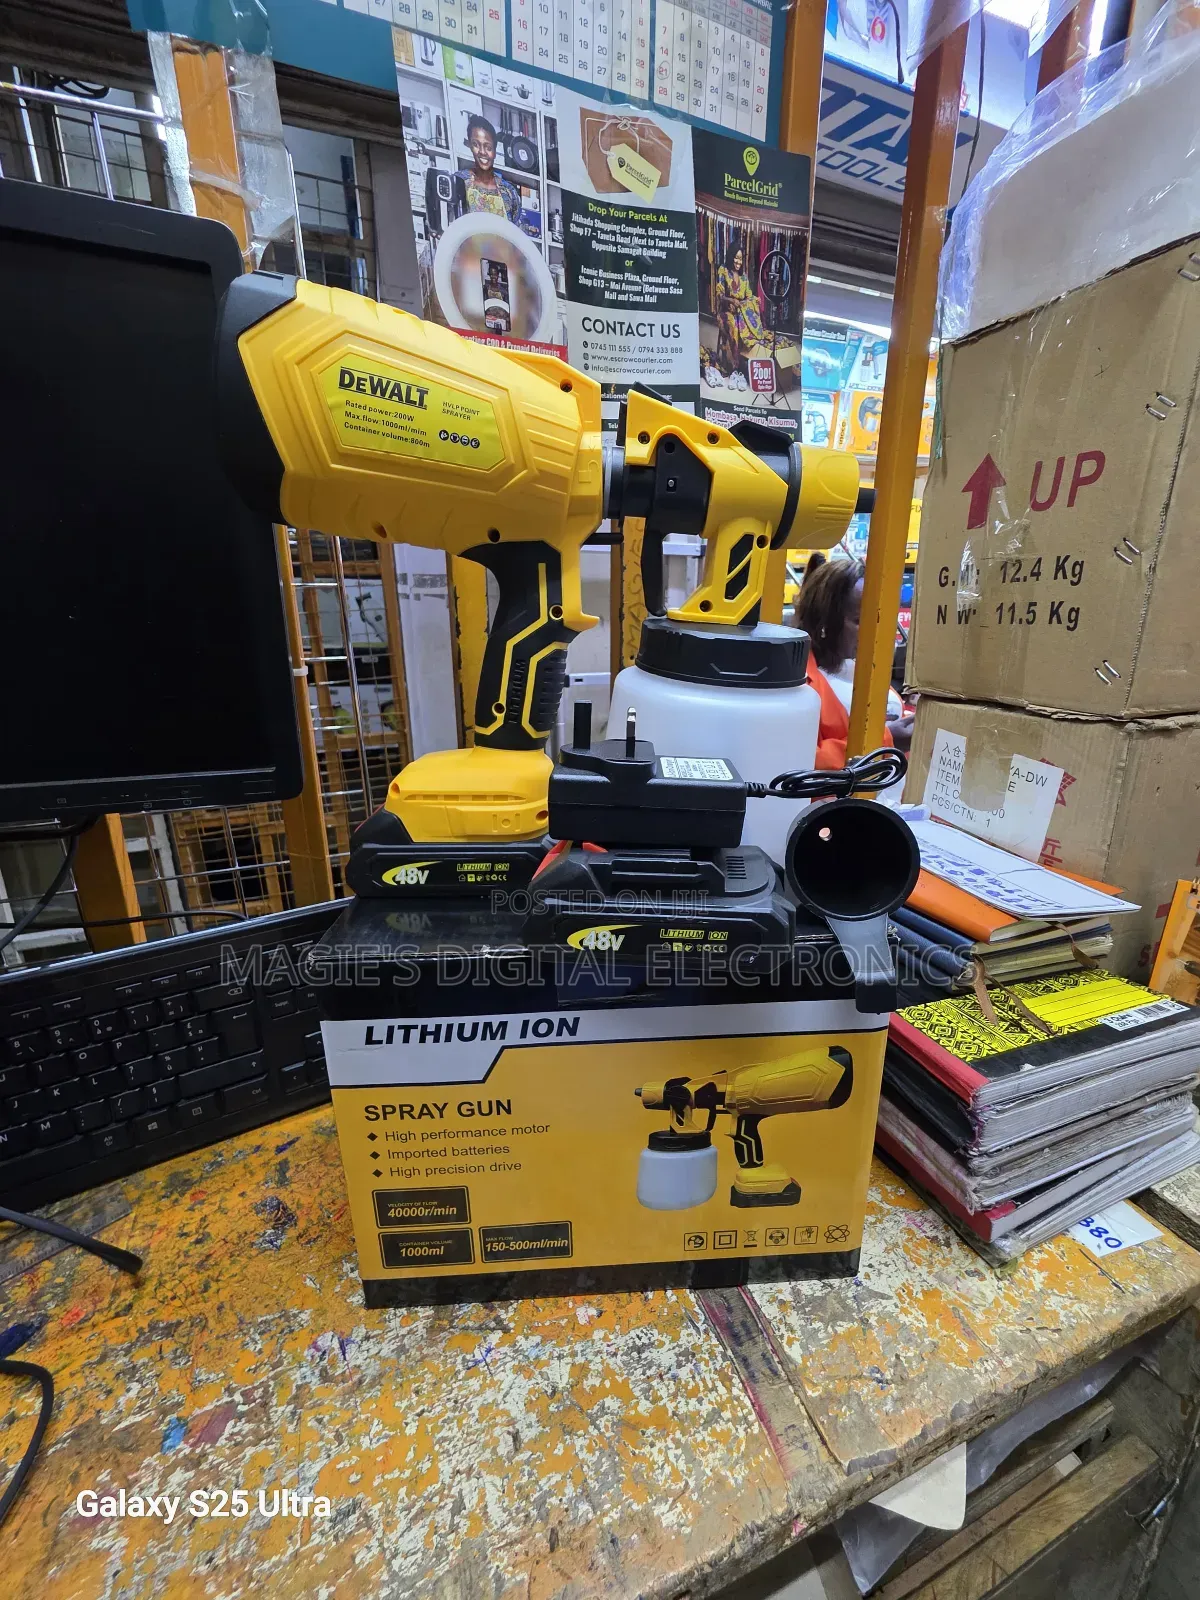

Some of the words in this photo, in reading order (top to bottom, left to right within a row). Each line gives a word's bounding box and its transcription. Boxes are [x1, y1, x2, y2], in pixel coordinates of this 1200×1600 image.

[399, 3, 411, 14] 28
[422, 10, 433, 21] 29
[445, 17, 456, 28] 30
[467, 24, 478, 35] 31
[517, 19, 528, 30] 16
[539, 26, 549, 36] 17
[559, 33, 569, 43] 18
[579, 39, 589, 50] 19
[597, 45, 608, 56] 20
[617, 52, 626, 62] 21
[635, 59, 645, 69] 22
[517, 41, 528, 52] 23
[538, 47, 549, 58] 24
[558, 54, 569, 64] 25
[578, 60, 588, 71] 26
[597, 66, 607, 76] 27
[616, 72, 626, 83] 28
[635, 79, 645, 89] 29
[588, 202, 607, 216] Drop
[608, 207, 627, 219] Your
[628, 210, 657, 222] Parcels
[658, 214, 668, 223] At
[569, 223, 584, 236] Shop
[584, 227, 592, 237] F7
[597, 230, 615, 241] Taveta
[616, 235, 631, 244] Road
[647, 238, 655, 246] to
[655, 238, 674, 248] Taveta
[674, 241, 689, 250] Mall,
[594, 219, 621, 233] Shopping
[648, 227, 669, 237] Ground
[669, 229, 686, 239] Floor,
[591, 240, 616, 252] Opposite
[642, 248, 667, 259] Building
[578, 275, 592, 287] Shop
[610, 281, 621, 290] Moi
[621, 283, 642, 292] Avenue
[581, 265, 598, 277] Iconic
[598, 268, 624, 280] Business
[624, 272, 641, 282] Plaza,
[642, 274, 663, 283] Ground
[663, 276, 680, 285] Floor,
[604, 291, 617, 300] Mall
[617, 292, 628, 301] and
[644, 294, 657, 303] Mall
[581, 316, 655, 338] CONTACT
[661, 323, 681, 339] US
[500, 340, 505, 348] &
[590, 342, 607, 351] 0745
[608, 344, 617, 352] 111
[591, 354, 673, 364] www.escrowcourier.com
[753, 368, 771, 380] 200!
[345, 400, 367, 411] Rated
[368, 406, 415, 423] power:200W
[441, 408, 472, 421] SPRAYER
[442, 401, 460, 411] HVLP
[460, 405, 480, 416] POINT
[705, 406, 740, 422] Mombasa,
[767, 416, 798, 429] Kisumu,
[344, 421, 380, 436] Container
[381, 431, 430, 448] volume:800m
[1030, 450, 1106, 512] UP
[1000, 556, 1043, 584] 12.4
[1053, 554, 1085, 587] Kg
[995, 601, 1038, 625] 11.5
[1048, 601, 1081, 632] Kg
[935, 781, 950, 796] TTL
[931, 794, 977, 822] PCS/CTN:
[985, 818, 991, 828] 1
[456, 863, 492, 871] LITHIUM
[494, 863, 510, 871] ION
[659, 928, 704, 940] LITHIUM
[707, 931, 729, 941] ION
[364, 1020, 509, 1046] LITHIUM
[519, 1017, 581, 1039] ION
[364, 1102, 449, 1122] SPRAY
[457, 1099, 513, 1118] GUN
[385, 1130, 417, 1144] High
[421, 1126, 507, 1143] performance
[511, 1123, 550, 1136] motor
[387, 1148, 447, 1162] Imported
[452, 1144, 510, 1157] batteries
[389, 1165, 421, 1179] High
[425, 1162, 485, 1178] precision
[489, 1160, 522, 1173] drive
[387, 1205, 457, 1218] 40000r/min
[399, 1245, 444, 1258] 1000ml
[485, 1238, 569, 1253] 150-500ml/min
